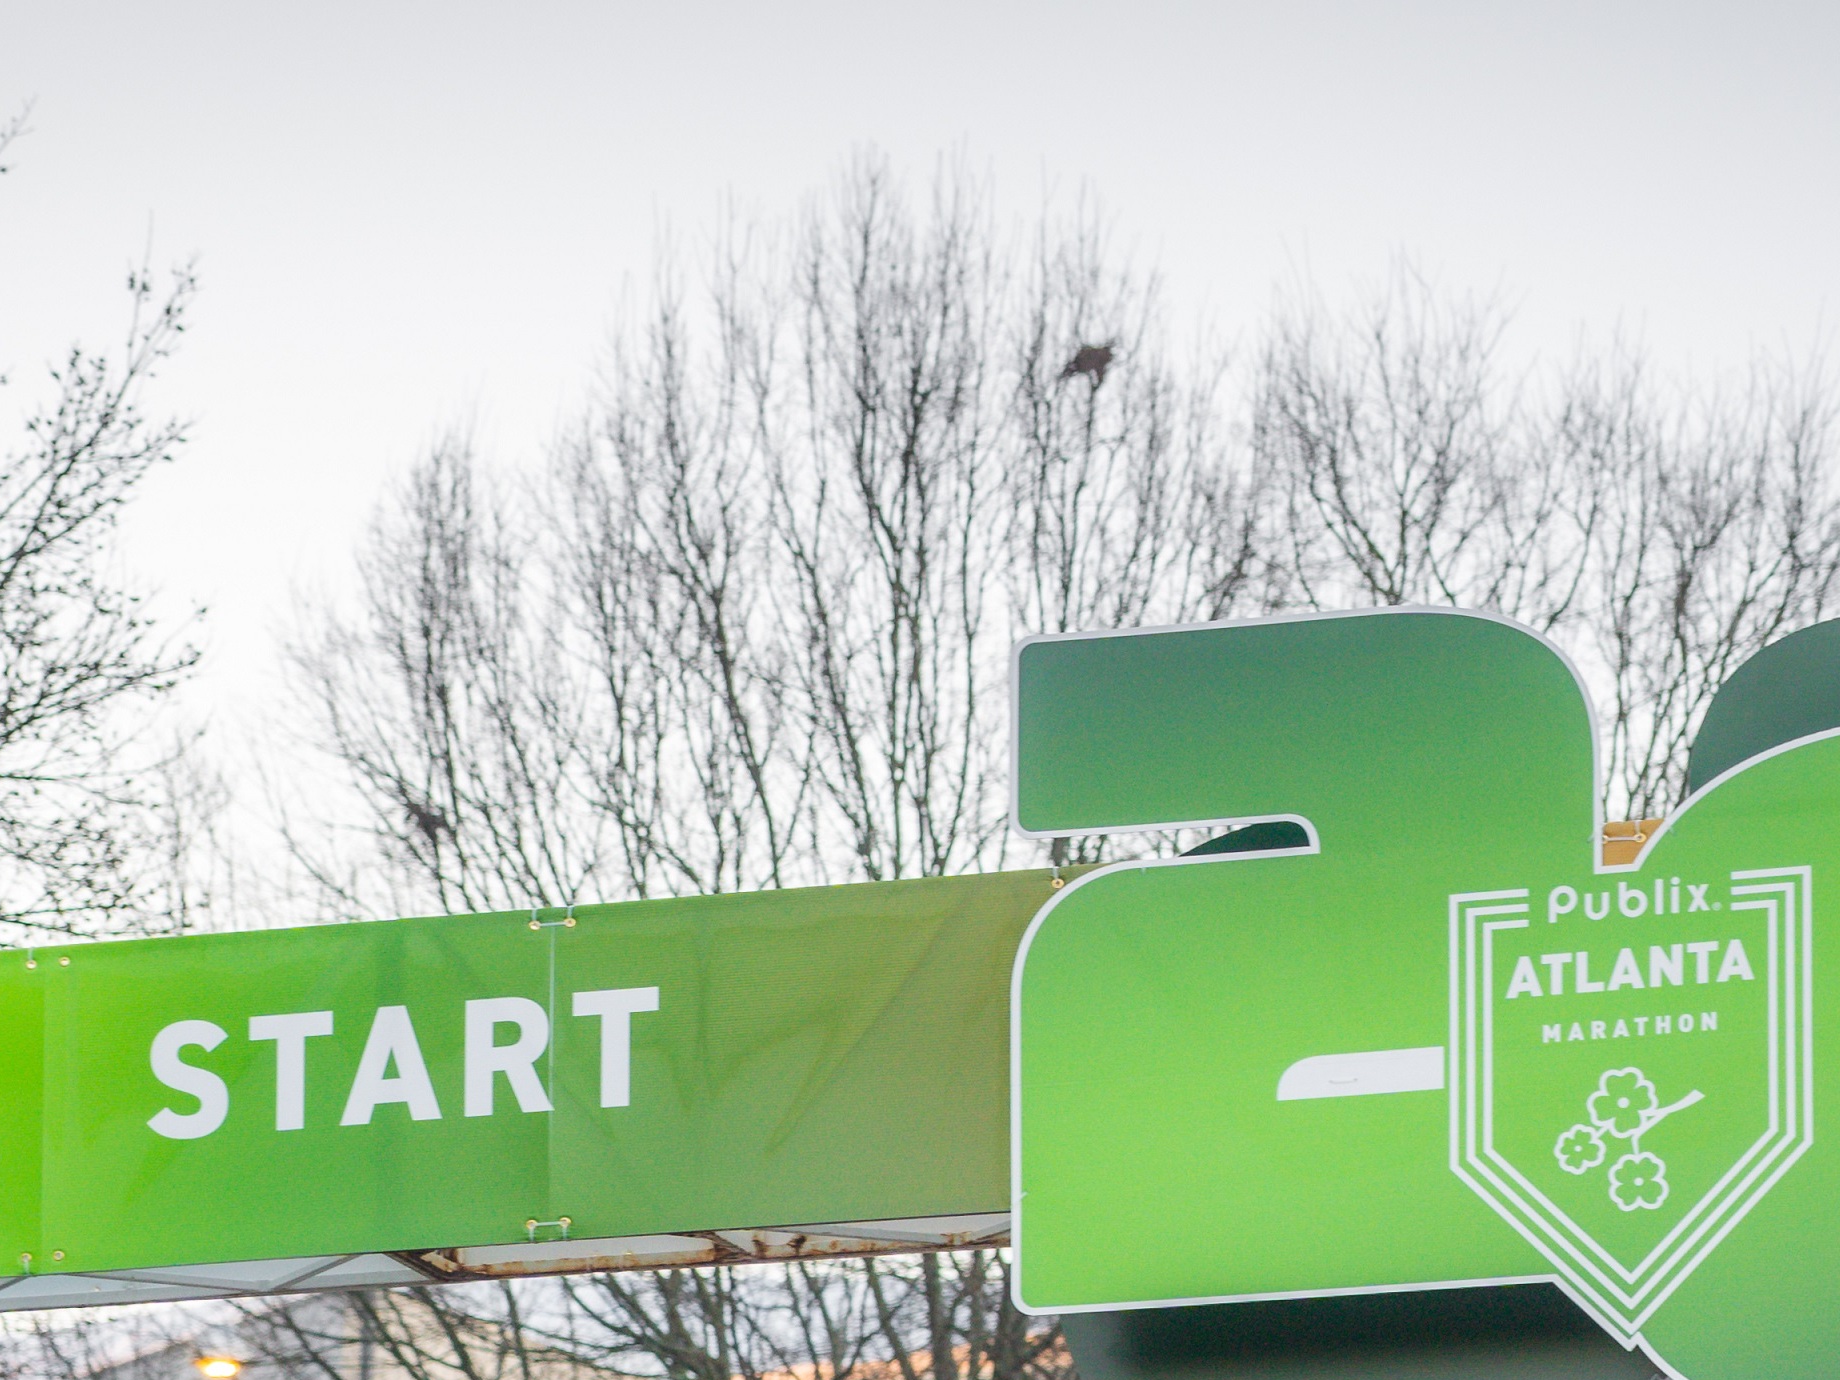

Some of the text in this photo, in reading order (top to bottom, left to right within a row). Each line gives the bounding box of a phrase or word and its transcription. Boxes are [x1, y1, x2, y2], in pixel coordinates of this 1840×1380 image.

[1547, 876, 1711, 924] Publix
[1505, 938, 1755, 1001] ATLANTA
[1542, 1011, 1719, 1043] MARATHON
[145, 985, 660, 1140] START
